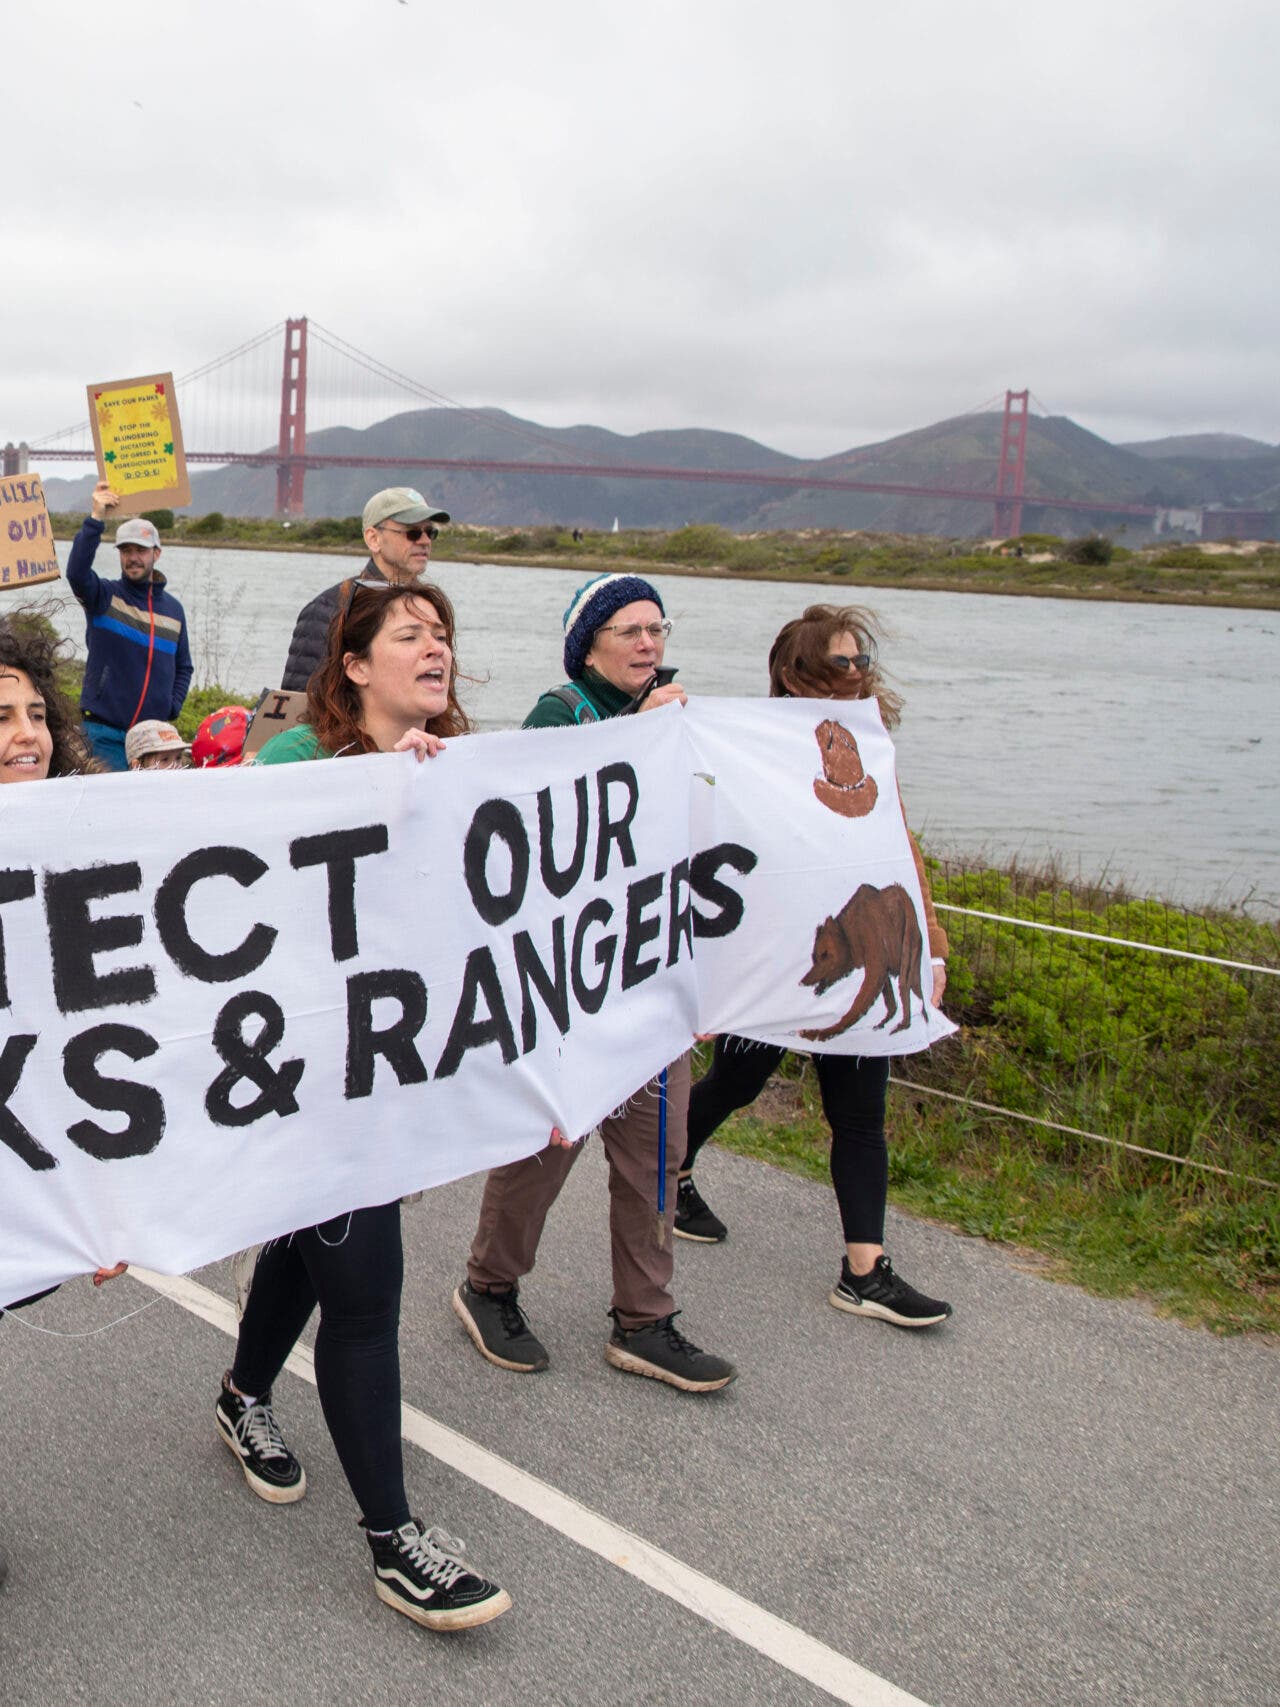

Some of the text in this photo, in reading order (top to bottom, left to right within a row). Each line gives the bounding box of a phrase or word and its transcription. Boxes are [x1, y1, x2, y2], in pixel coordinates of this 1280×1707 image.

[7, 513, 48, 543] OUT
[263, 695, 291, 720] I
[462, 760, 641, 927] OUR
[203, 990, 307, 1128] &
[344, 841, 760, 1100] RANGERS
